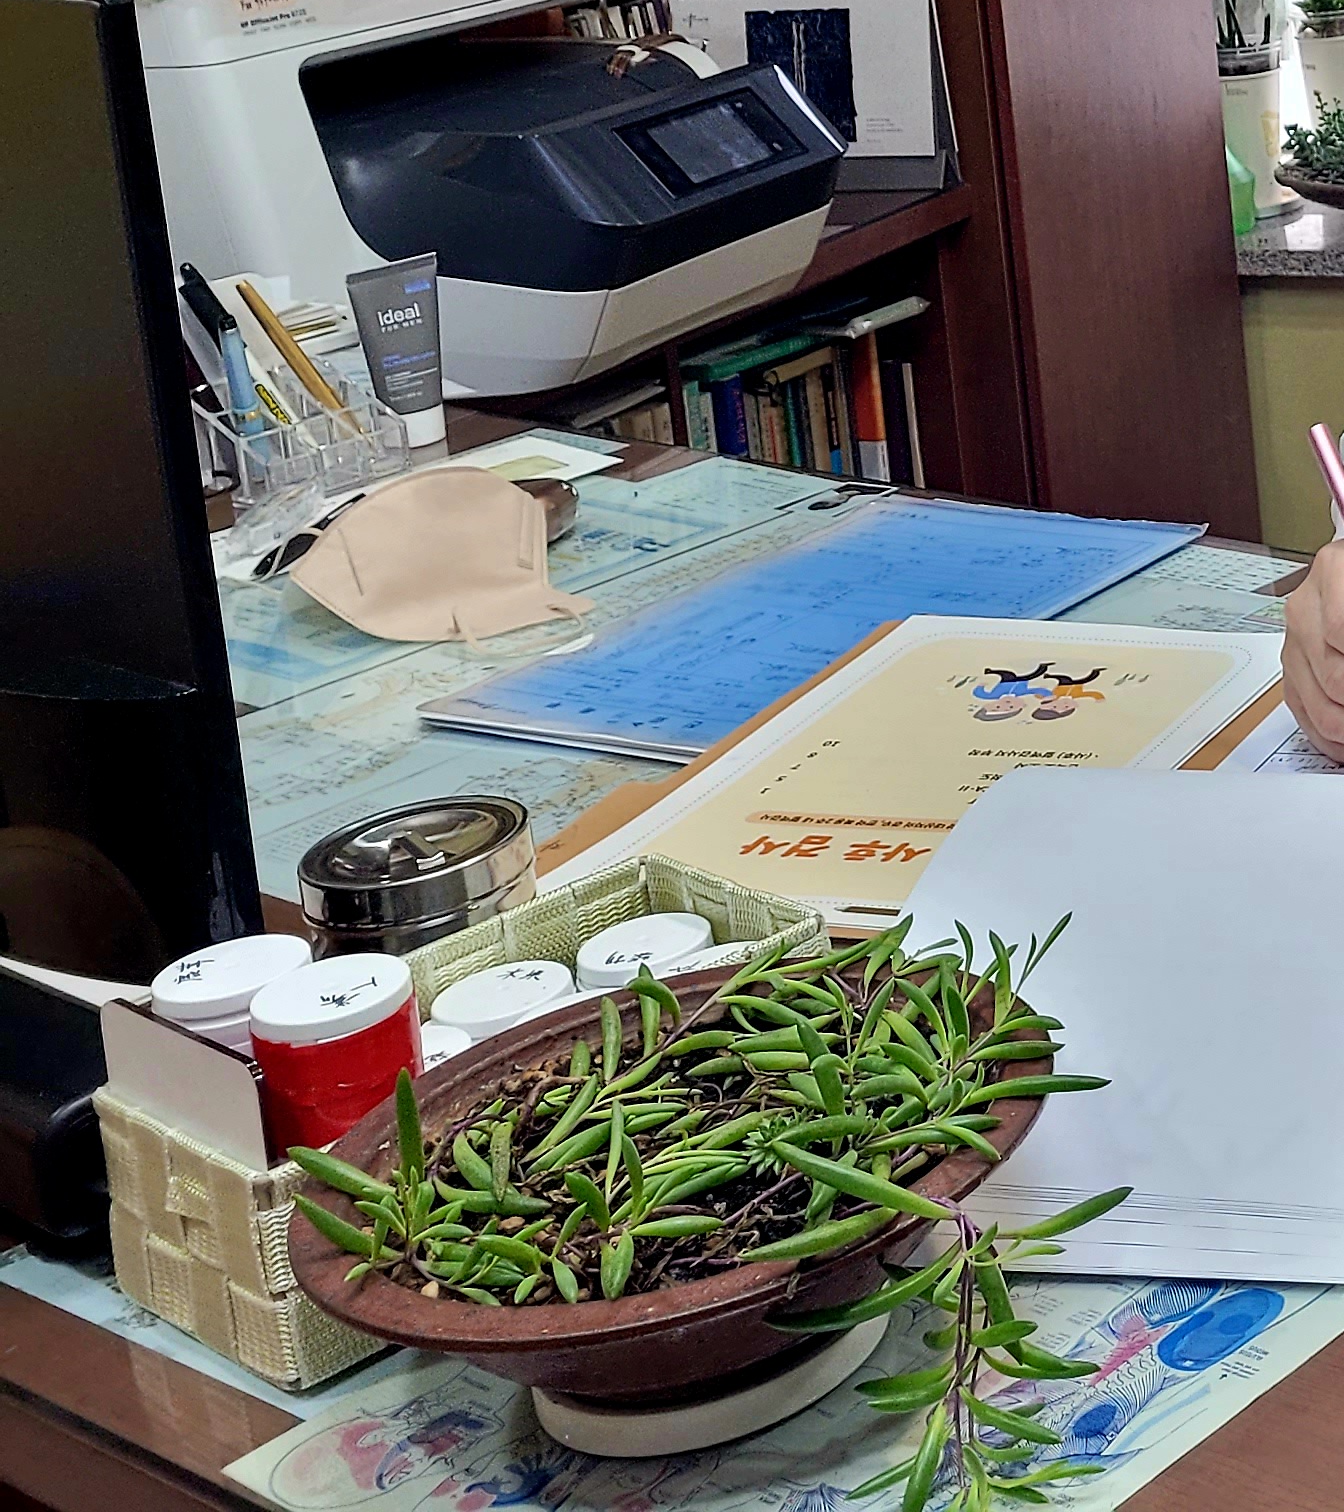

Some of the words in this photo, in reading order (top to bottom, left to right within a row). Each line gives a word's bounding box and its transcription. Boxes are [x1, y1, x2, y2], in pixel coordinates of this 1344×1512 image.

[822, 740, 840, 748] 10
[738, 834, 833, 858] 검사
[843, 839, 932, 863] 사후
